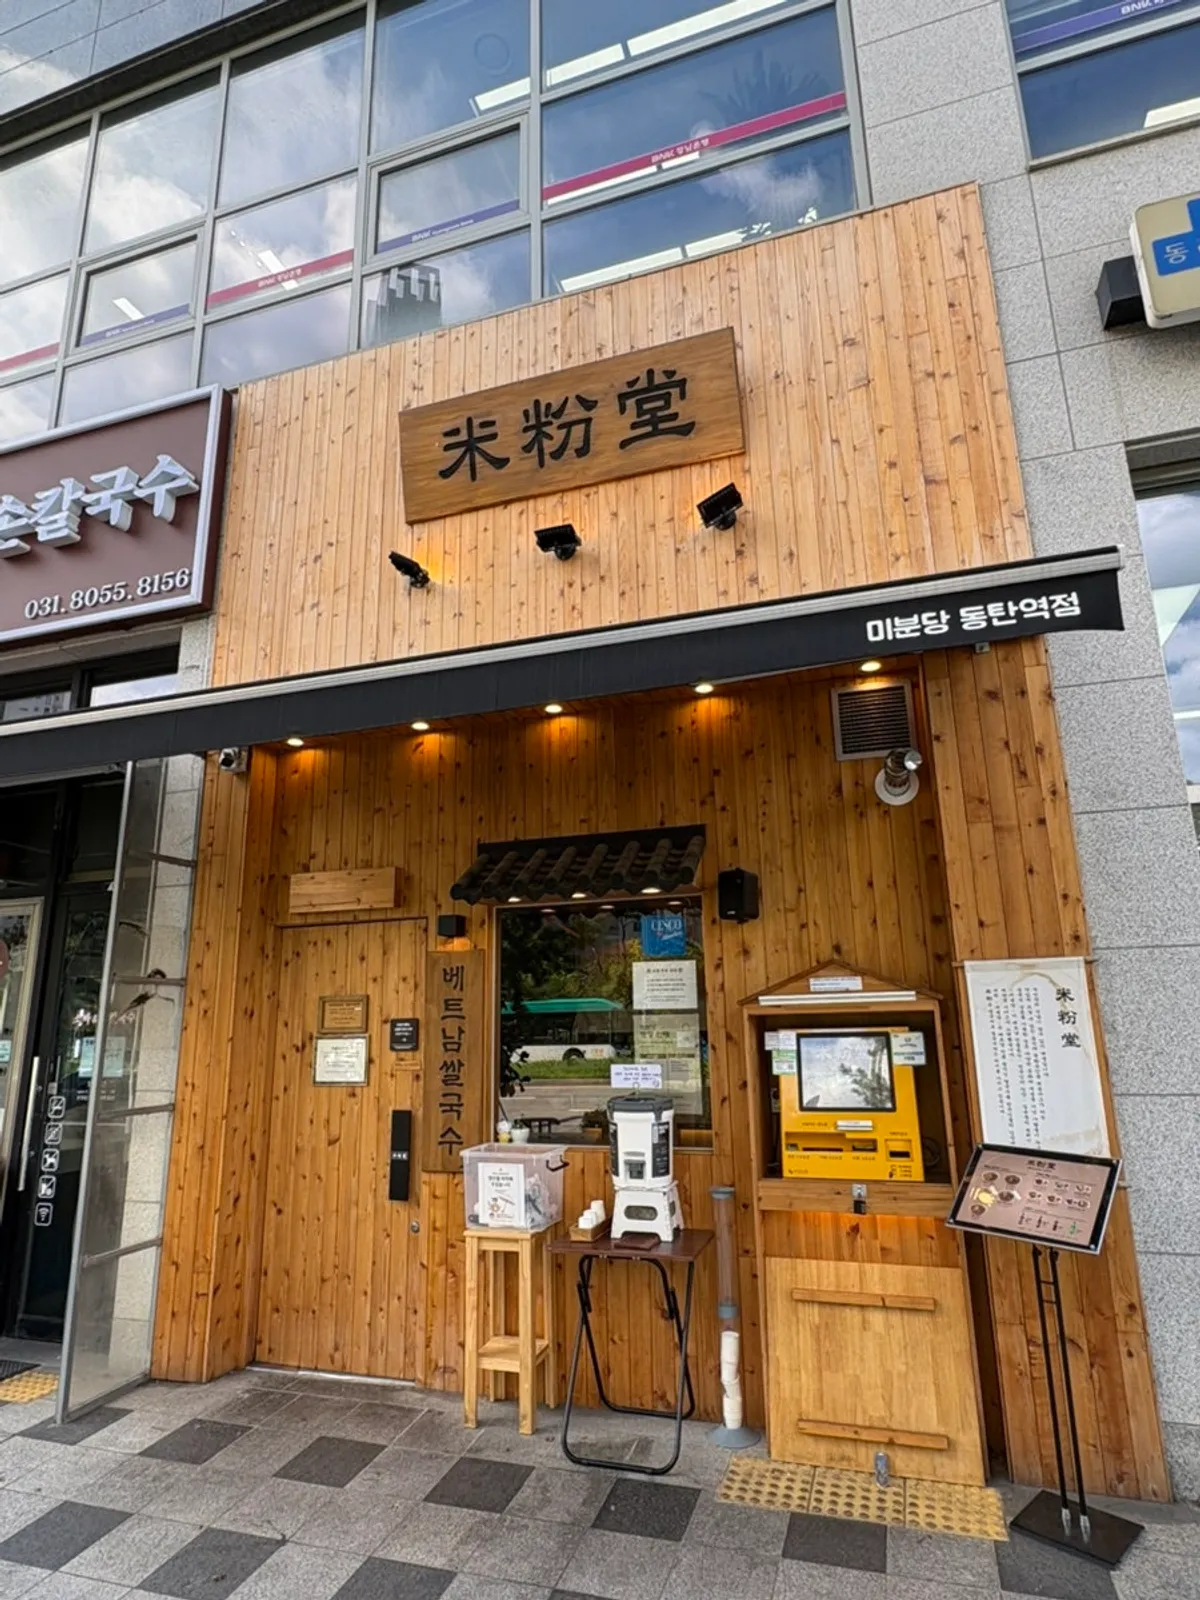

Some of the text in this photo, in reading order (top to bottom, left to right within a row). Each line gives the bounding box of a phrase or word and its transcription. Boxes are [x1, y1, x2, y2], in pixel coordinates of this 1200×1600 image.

[1164, 242, 1200, 265] 동
[438, 368, 696, 482] 米粉堂
[866, 591, 1082, 642] 미분당 동탄역점
[1055, 986, 1082, 1049] 米粉堂
